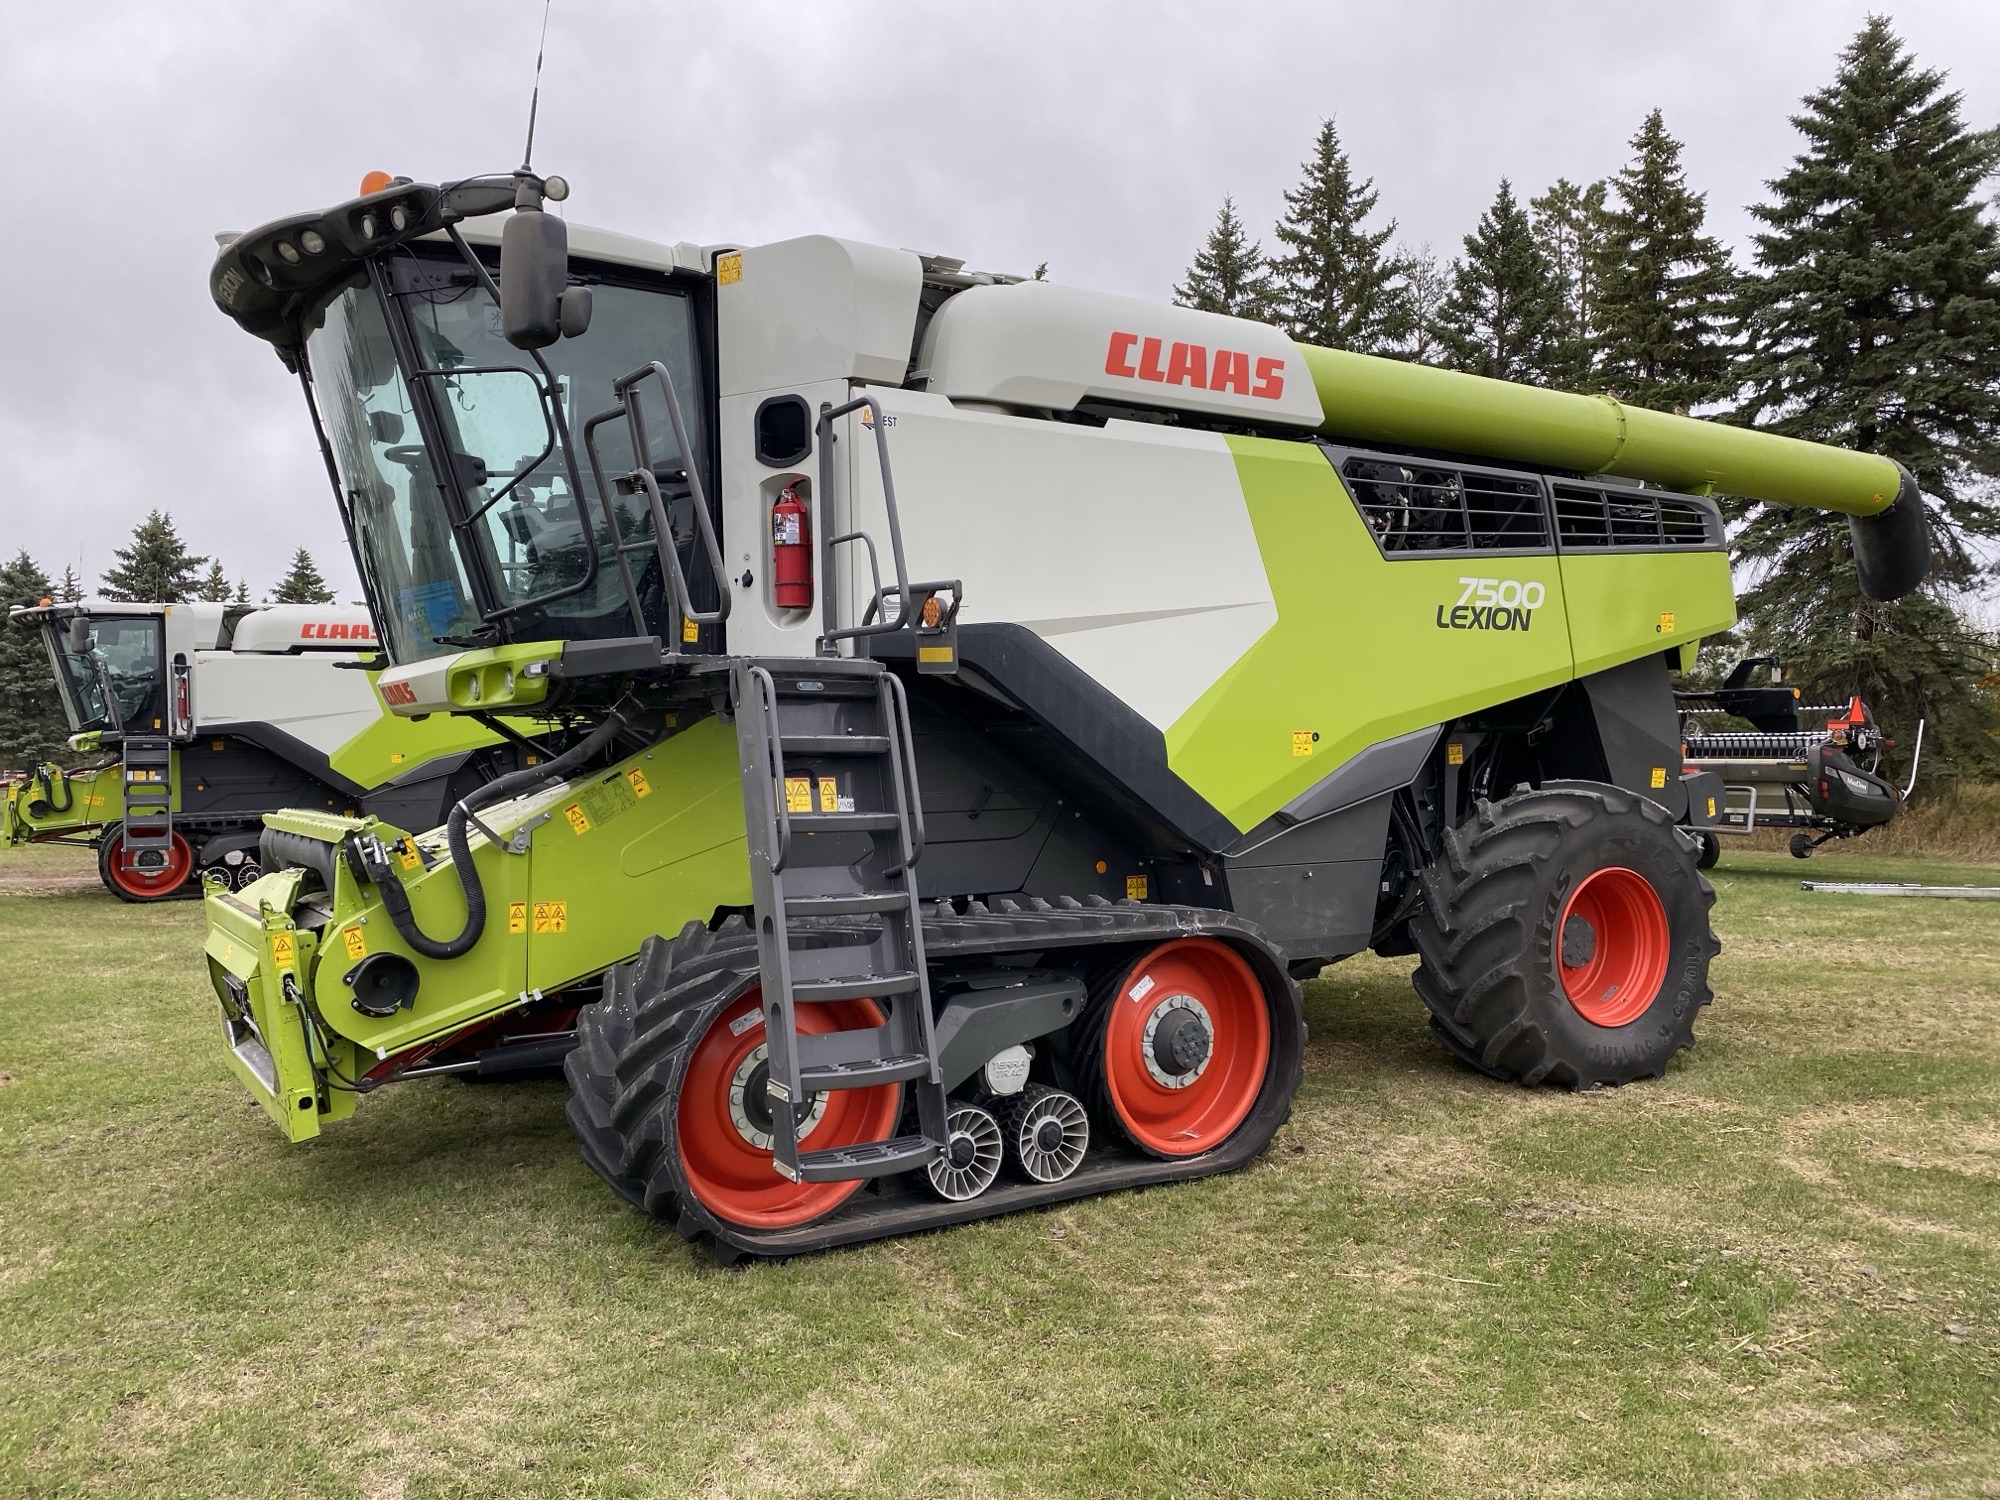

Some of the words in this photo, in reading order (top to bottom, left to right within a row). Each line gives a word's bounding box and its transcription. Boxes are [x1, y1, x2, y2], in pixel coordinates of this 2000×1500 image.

[218, 267, 245, 305] LEXION
[1105, 331, 1285, 400] CLAAS
[1456, 577, 1546, 609] 7500
[1436, 604, 1532, 632] LEXION
[1847, 777, 1867, 790] MacDon
[992, 1060, 1026, 1071] TERRA
[995, 1067, 1022, 1079] TRAC
